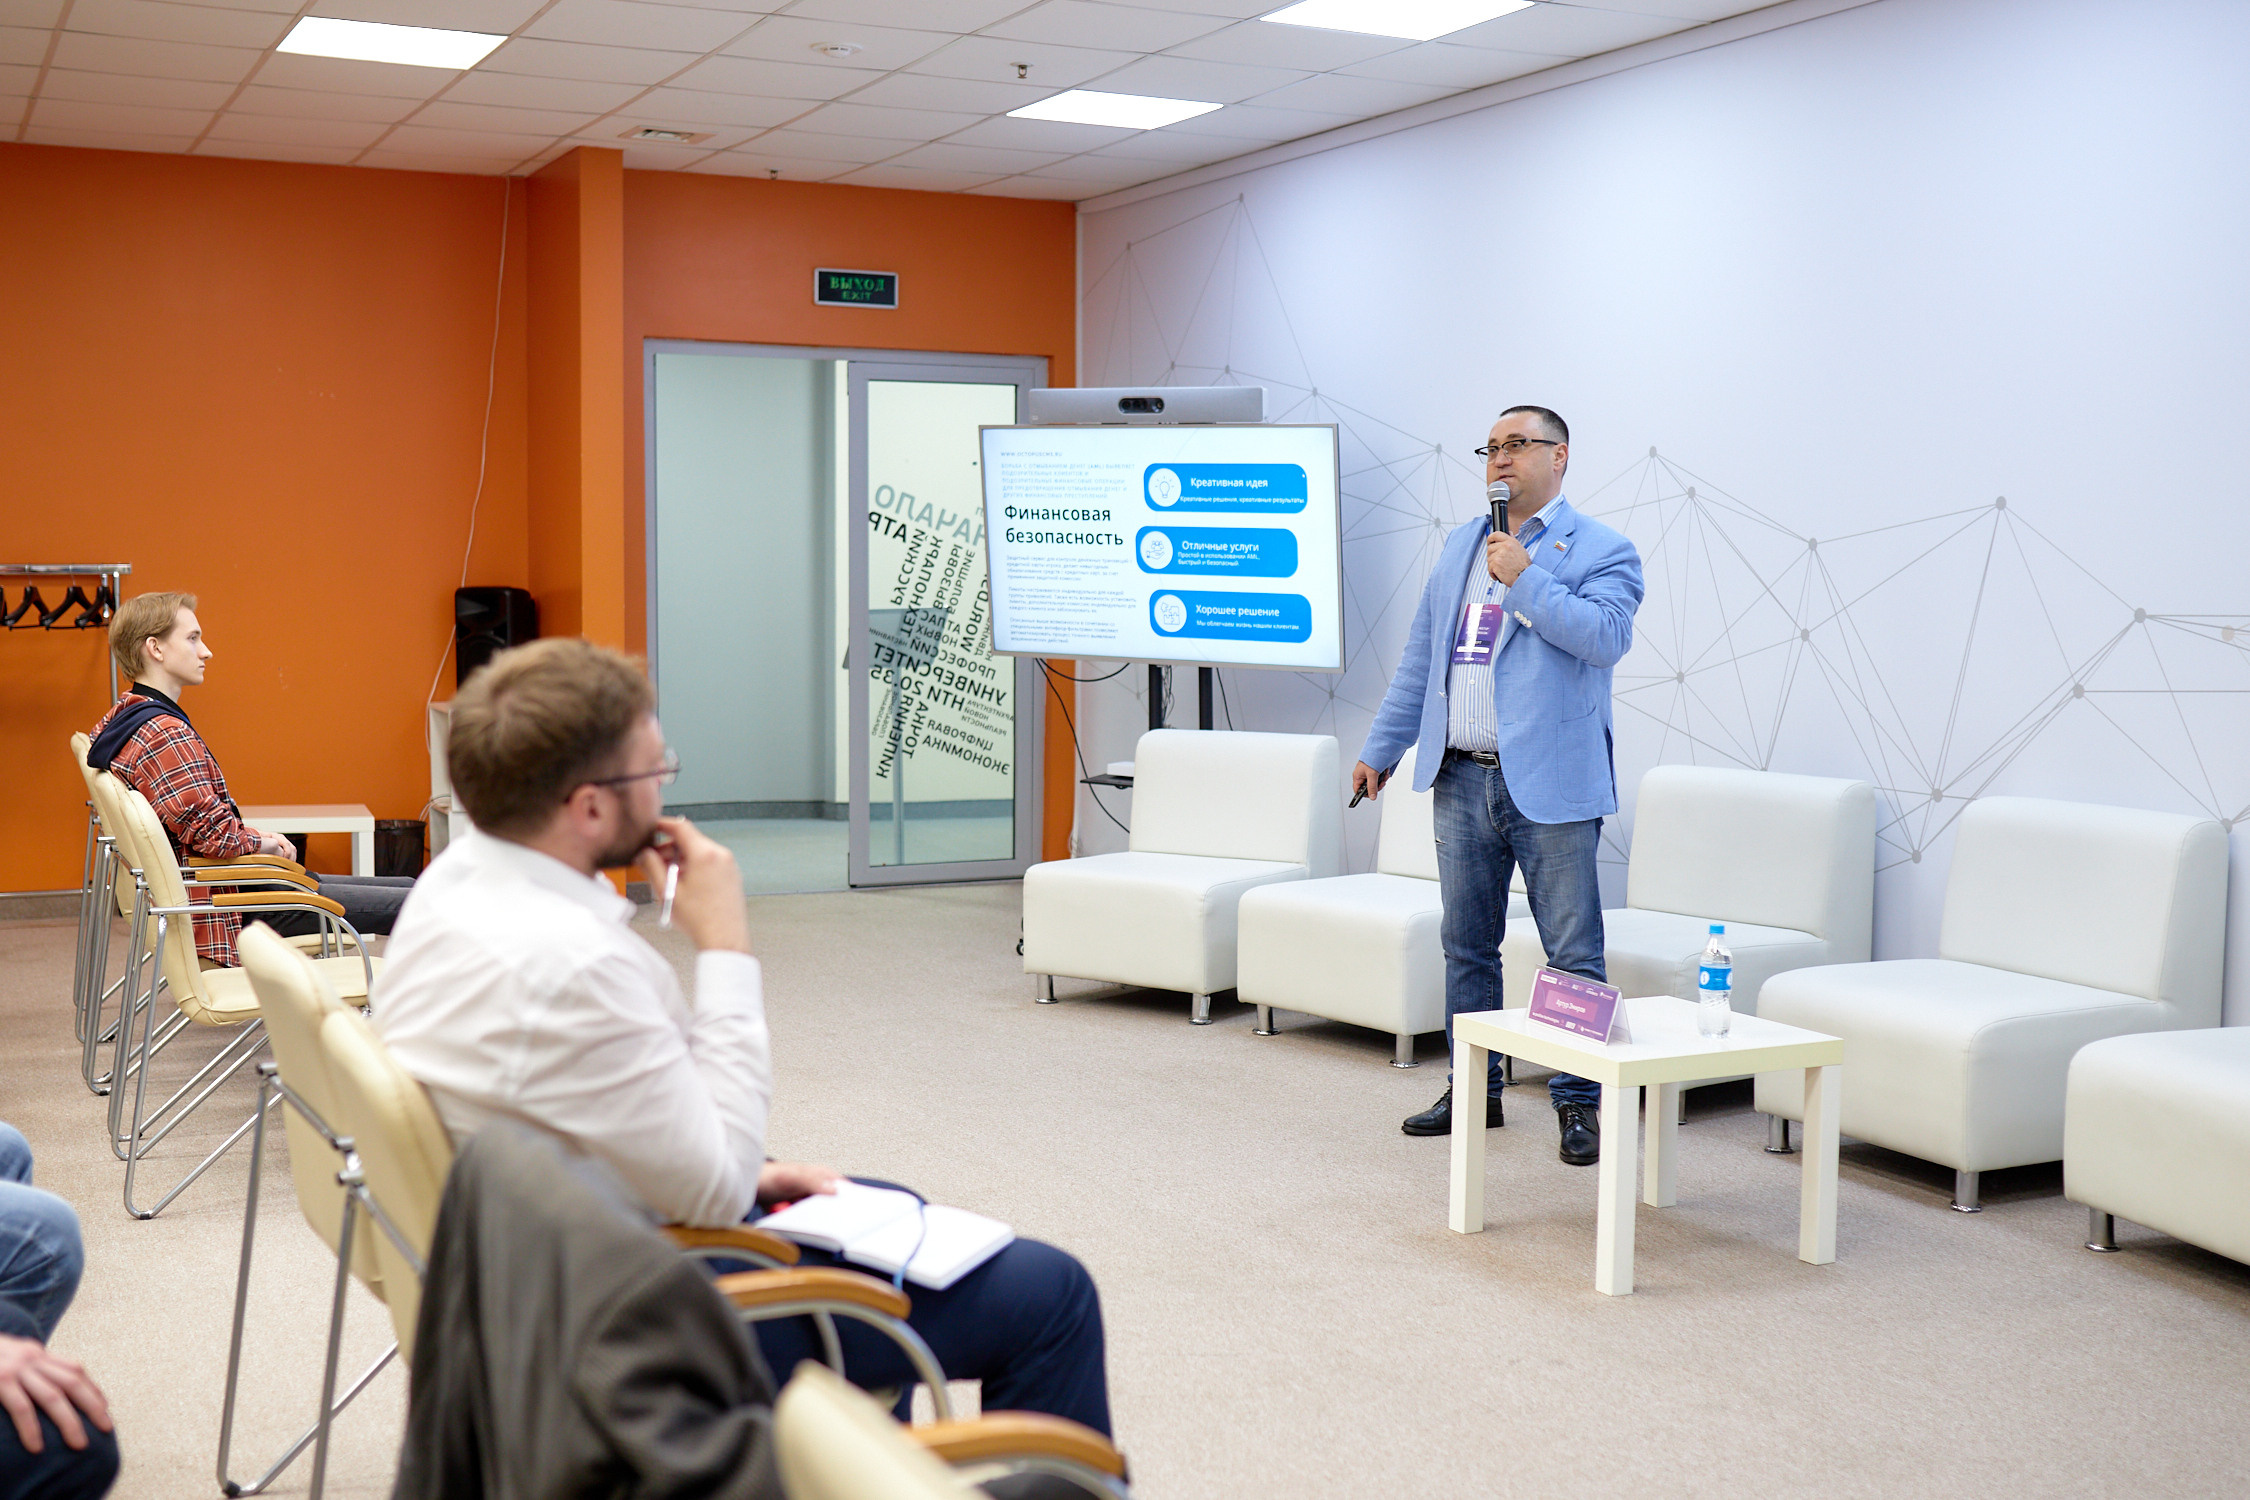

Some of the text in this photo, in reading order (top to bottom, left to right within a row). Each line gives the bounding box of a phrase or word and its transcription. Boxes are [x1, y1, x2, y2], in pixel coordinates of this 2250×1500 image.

[829, 275, 886, 292] ВЫХОД
[841, 291, 872, 300] EXIT
[1190, 477, 1269, 489] Креативная идея
[1004, 505, 1111, 521] Финансовая
[1005, 527, 1123, 545] безопасность
[1182, 540, 1259, 554] Отличные услуги
[1196, 604, 1280, 617] Хорошее решение
